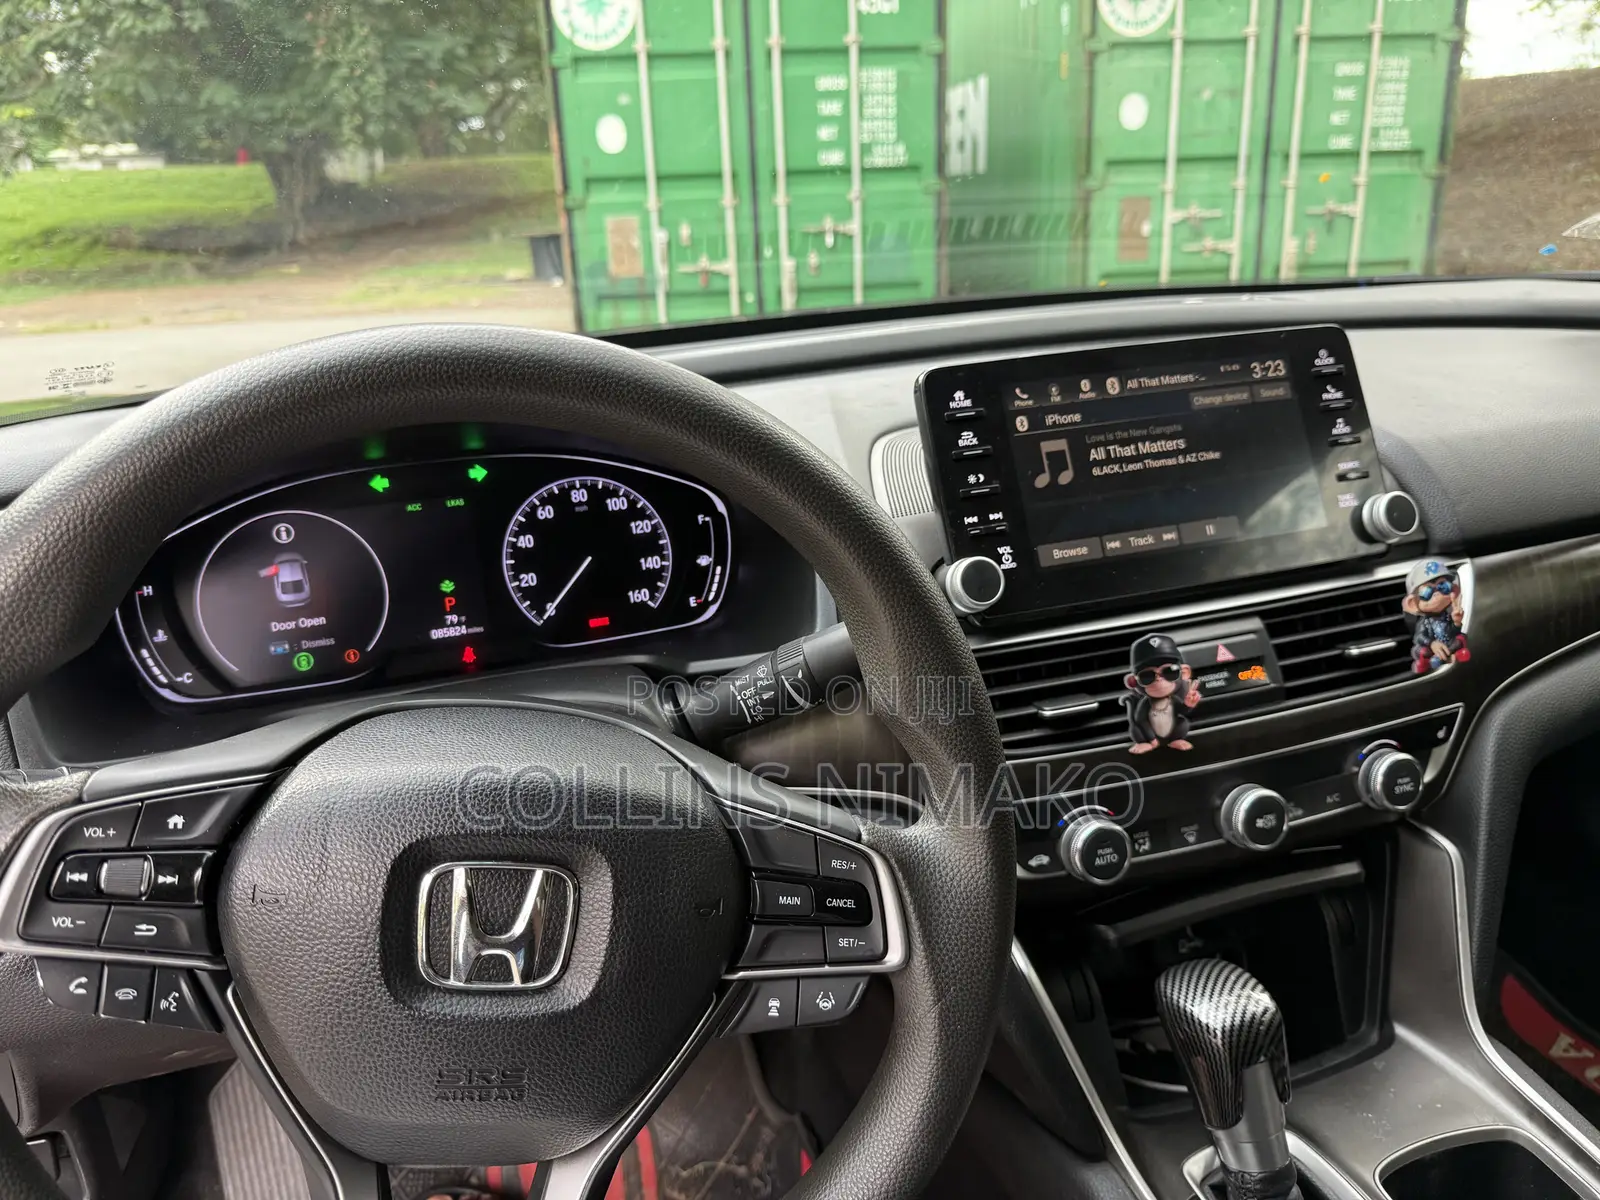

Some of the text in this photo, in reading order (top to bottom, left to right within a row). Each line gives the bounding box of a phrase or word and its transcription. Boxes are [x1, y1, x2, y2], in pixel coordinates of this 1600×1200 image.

[1250, 358, 1286, 379] 3:23
[1139, 376, 1160, 388] That
[1161, 373, 1194, 386] Matters
[950, 399, 972, 409] HOME
[1045, 412, 1082, 426] iPhone
[958, 437, 978, 447] BACK
[1089, 437, 1187, 461] All That Matters
[1123, 460, 1143, 472] Leon
[1144, 456, 1177, 469] Thomas
[1185, 451, 1198, 463] AZ
[1198, 450, 1222, 462] Chike
[570, 488, 588, 502] 80
[406, 503, 422, 511] ACC
[446, 498, 465, 507] LKAS
[606, 496, 628, 511] 100
[536, 505, 555, 520] 60
[697, 514, 705, 525] F
[630, 519, 652, 535] 120
[517, 534, 534, 549] 40
[1128, 535, 1155, 547] Track
[997, 546, 1013, 554] VOL
[1052, 546, 1088, 559] Browse
[640, 555, 662, 570] 140
[519, 572, 537, 587] 20
[142, 585, 153, 596] H
[628, 588, 651, 603] 160
[444, 597, 456, 612] P
[689, 596, 697, 607] E
[270, 615, 327, 632] Door Open
[444, 615, 458, 625] 79
[430, 626, 467, 640] 085824
[301, 637, 336, 650] Dismiss
[183, 672, 193, 684] C
[741, 686, 757, 700] OFF
[746, 695, 761, 707] INT
[750, 705, 763, 715] LO
[754, 714, 765, 723] HI
[1394, 782, 1414, 794] SYNC
[831, 859, 857, 871] RES/+
[1095, 853, 1118, 866] AUTO
[778, 895, 801, 906] MAIN
[826, 898, 857, 909] CANCEL
[438, 1067, 528, 1085] SRS
[435, 1088, 529, 1102] AIRBAG
